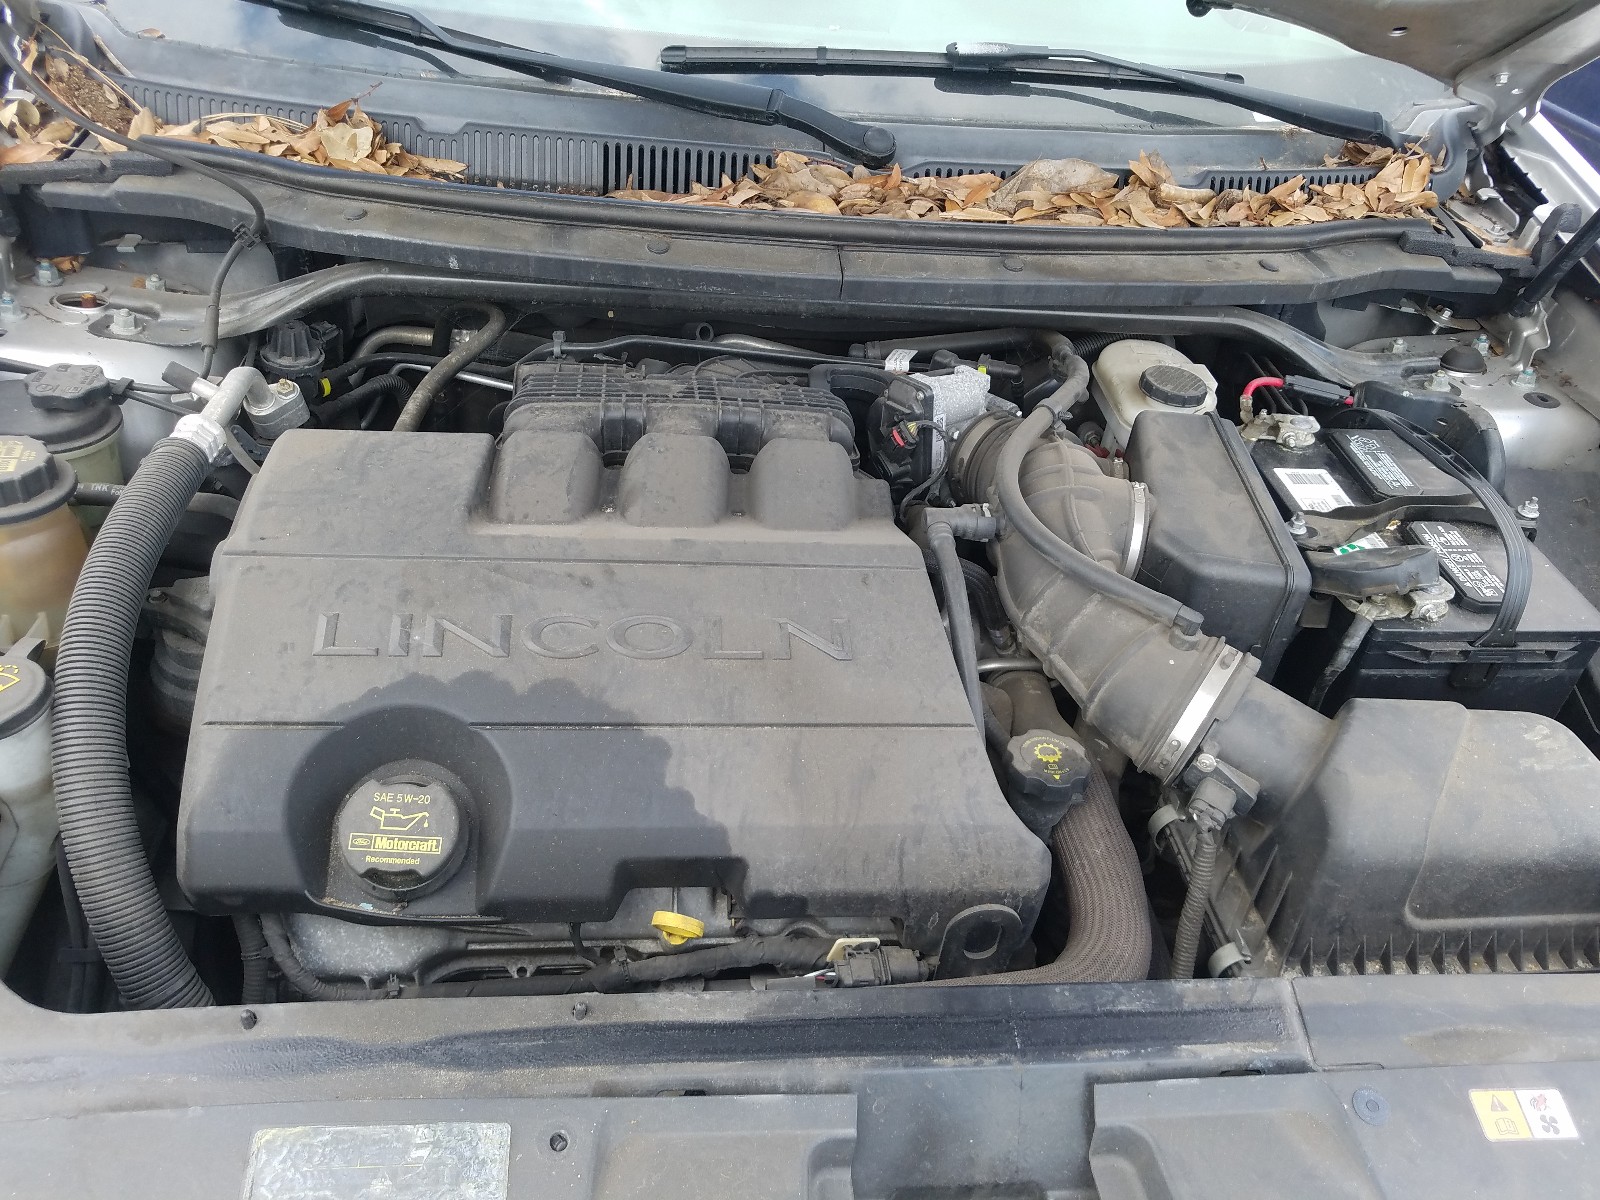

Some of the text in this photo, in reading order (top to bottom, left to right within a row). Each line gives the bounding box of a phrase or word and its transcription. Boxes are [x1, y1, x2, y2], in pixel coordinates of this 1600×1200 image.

[312, 612, 854, 661] LINCOLN
[373, 792, 431, 805] SAE 5W-20
[365, 855, 420, 865] Recommended
